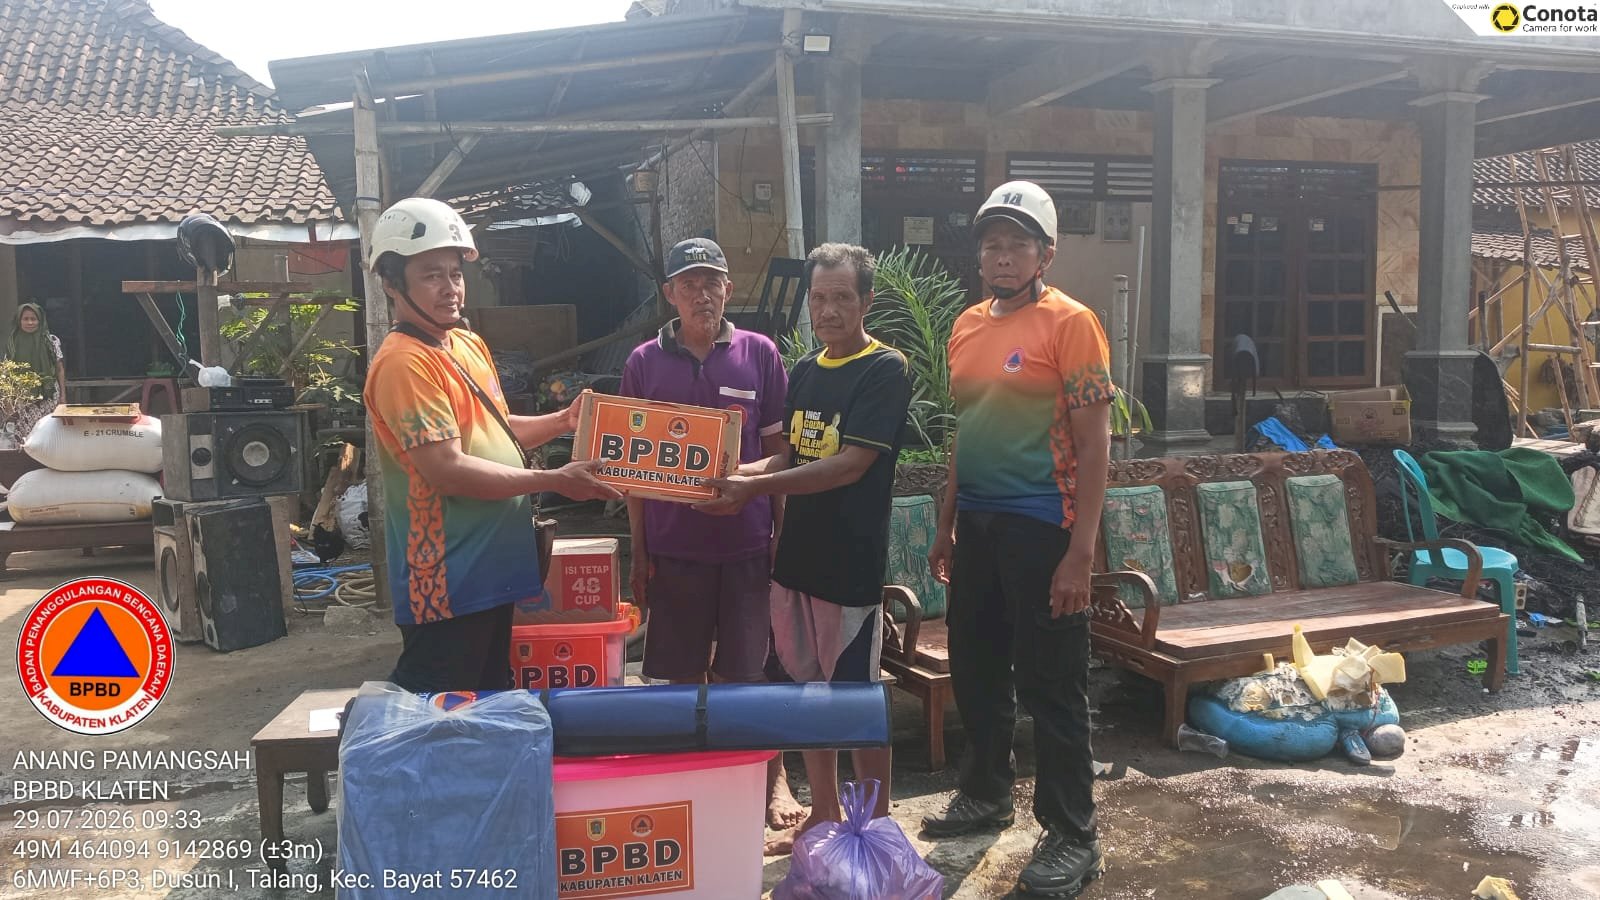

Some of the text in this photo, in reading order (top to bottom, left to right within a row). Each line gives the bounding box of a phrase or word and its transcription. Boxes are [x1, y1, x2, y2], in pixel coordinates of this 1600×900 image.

[105, 429, 144, 438] CRUMBLE
[600, 433, 711, 472] BPBD
[597, 466, 702, 487] KABUPATEN KLATE
[565, 565, 609, 575] ISI TETAP
[571, 577, 601, 594] 48
[575, 595, 601, 605] CUP
[560, 838, 682, 877] BPBD
[560, 870, 683, 892] KABUPATEN KLATEN
